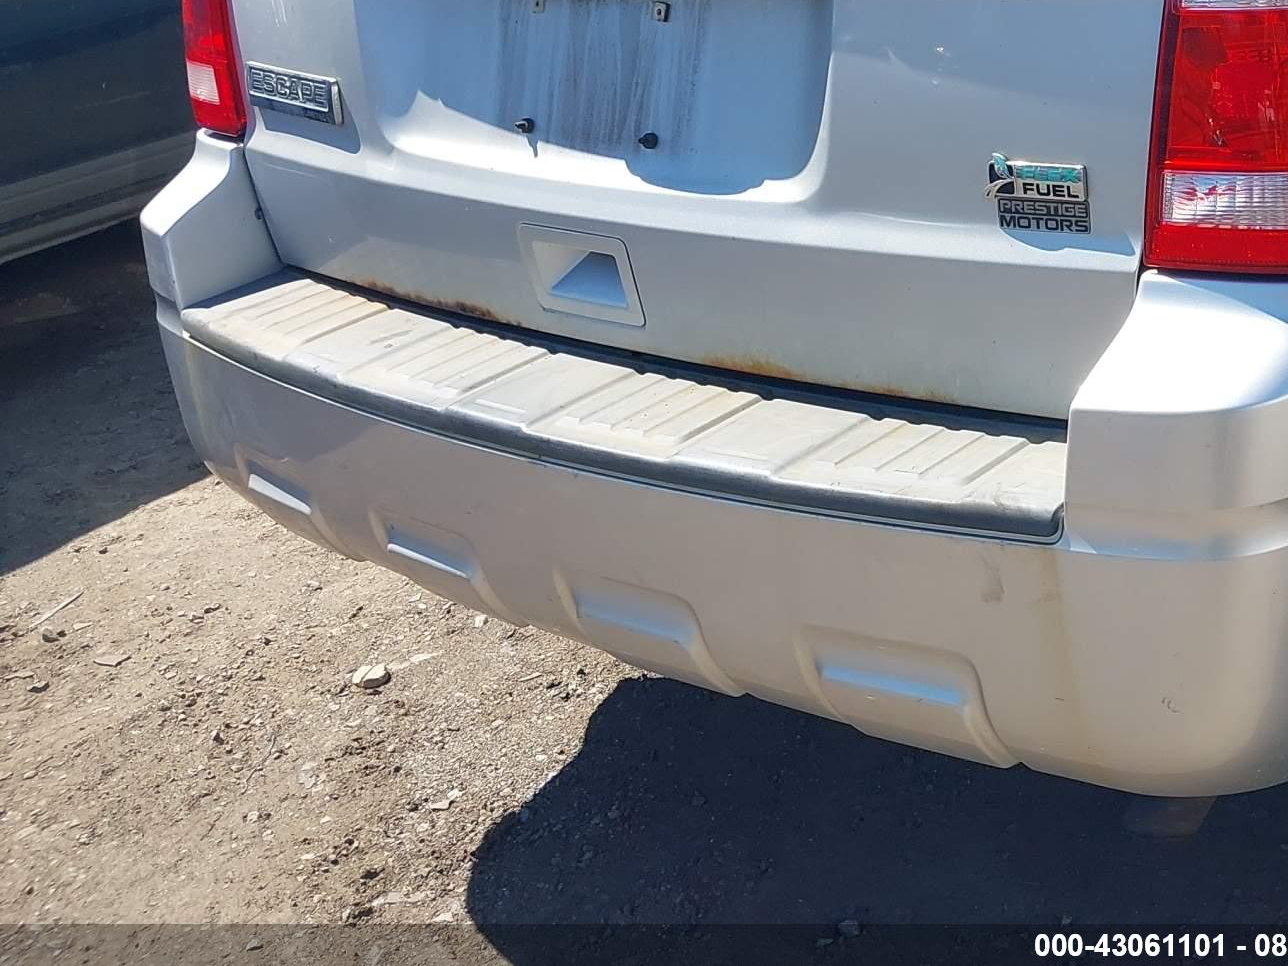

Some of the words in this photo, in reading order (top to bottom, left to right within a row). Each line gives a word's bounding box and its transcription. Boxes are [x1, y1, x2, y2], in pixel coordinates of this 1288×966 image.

[249, 67, 329, 109] ESCAPE
[1022, 182, 1080, 199] FUEL
[999, 199, 1087, 219] PRESTIGE
[999, 215, 1090, 233] MOTORS
